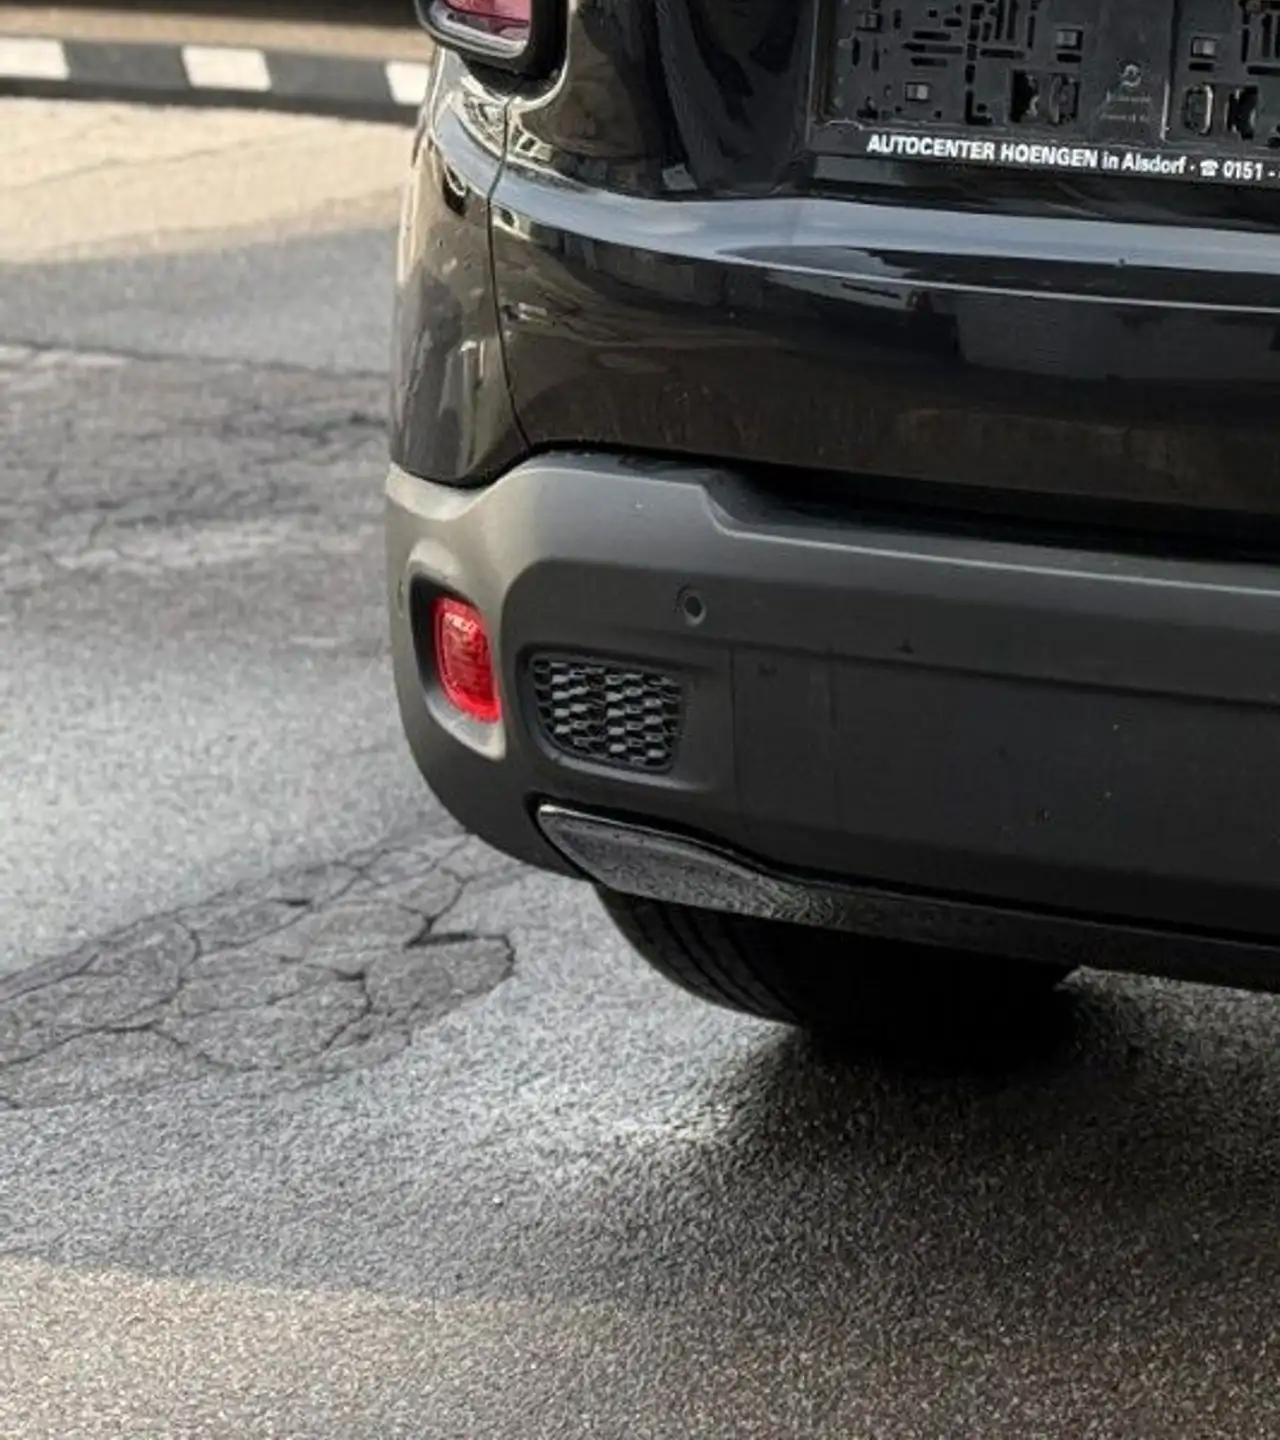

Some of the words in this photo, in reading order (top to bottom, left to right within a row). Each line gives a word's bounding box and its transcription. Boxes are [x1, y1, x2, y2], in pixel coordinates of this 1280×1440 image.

[867, 134, 995, 160] AUTOCENTER
[1000, 143, 1099, 169] HOENGEN
[1102, 151, 1119, 170] in
[1120, 152, 1188, 175] Alsdorf
[1222, 160, 1264, 182] 0151
